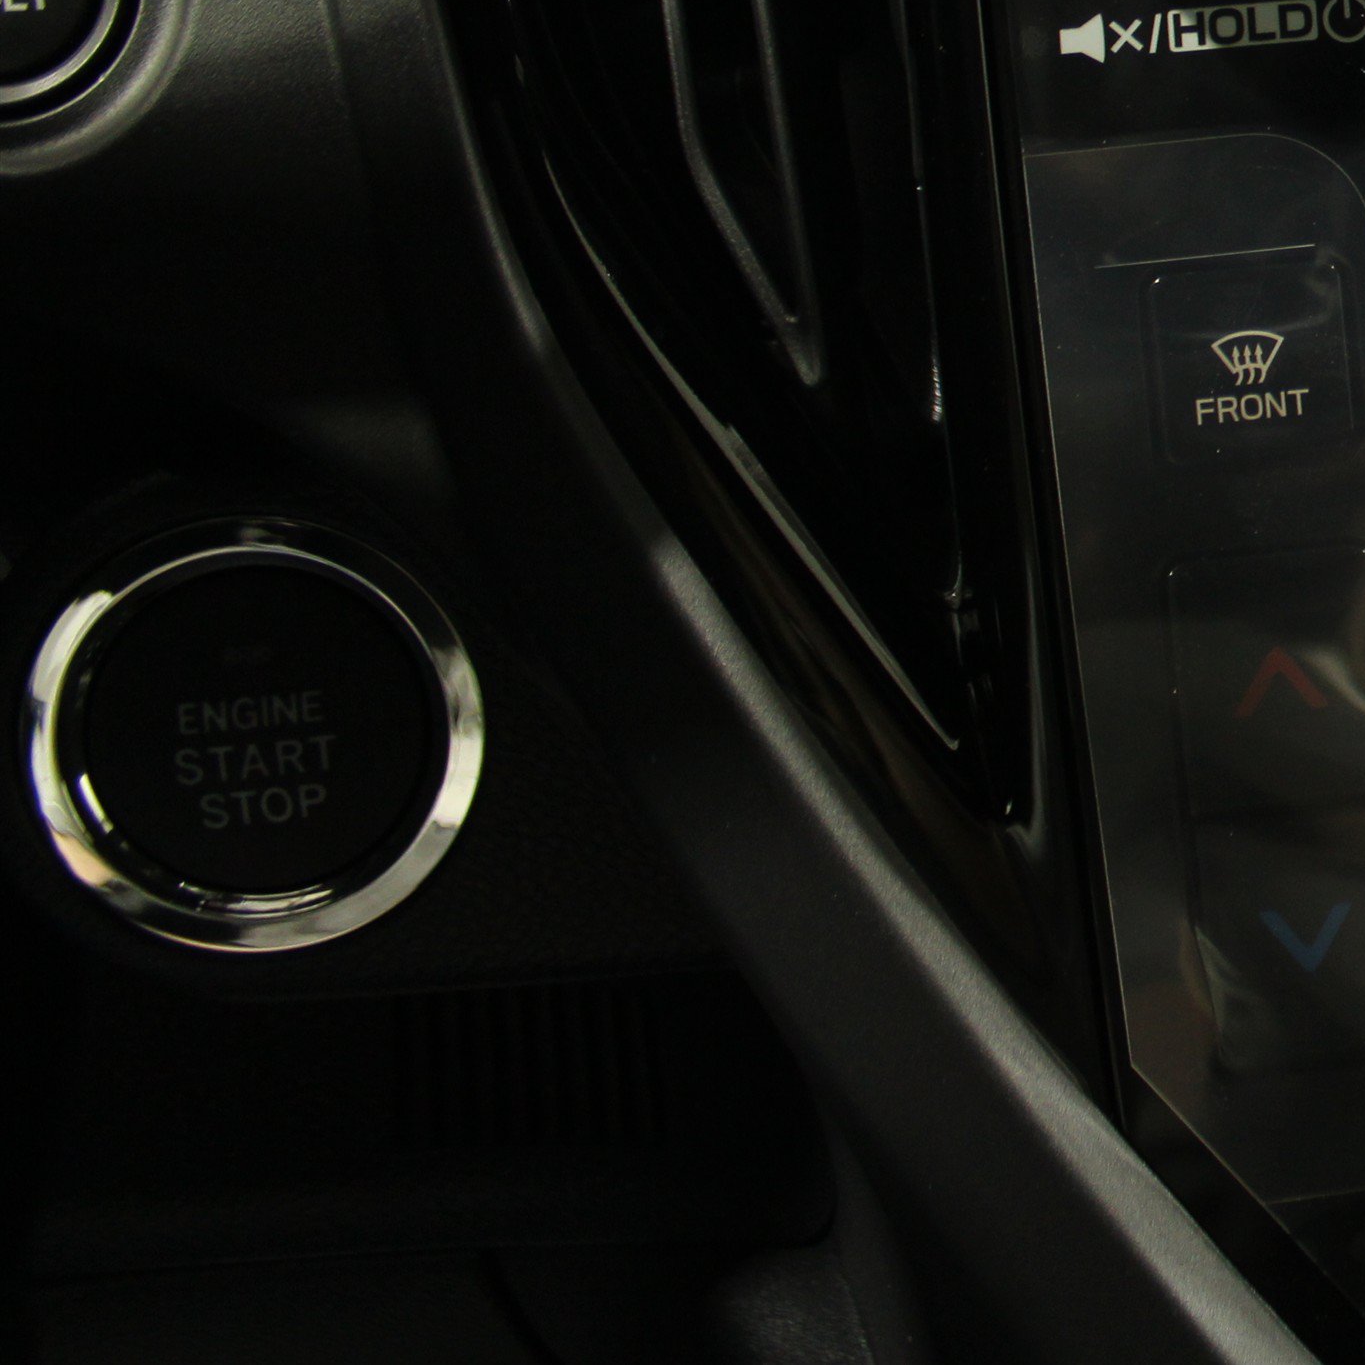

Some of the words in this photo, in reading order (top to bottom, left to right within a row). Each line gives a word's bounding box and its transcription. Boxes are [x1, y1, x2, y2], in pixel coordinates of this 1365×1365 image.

[1195, 388, 1310, 426] FRONT
[176, 689, 324, 735] ENGINE
[173, 734, 337, 786] START
[199, 783, 327, 829] STOP
